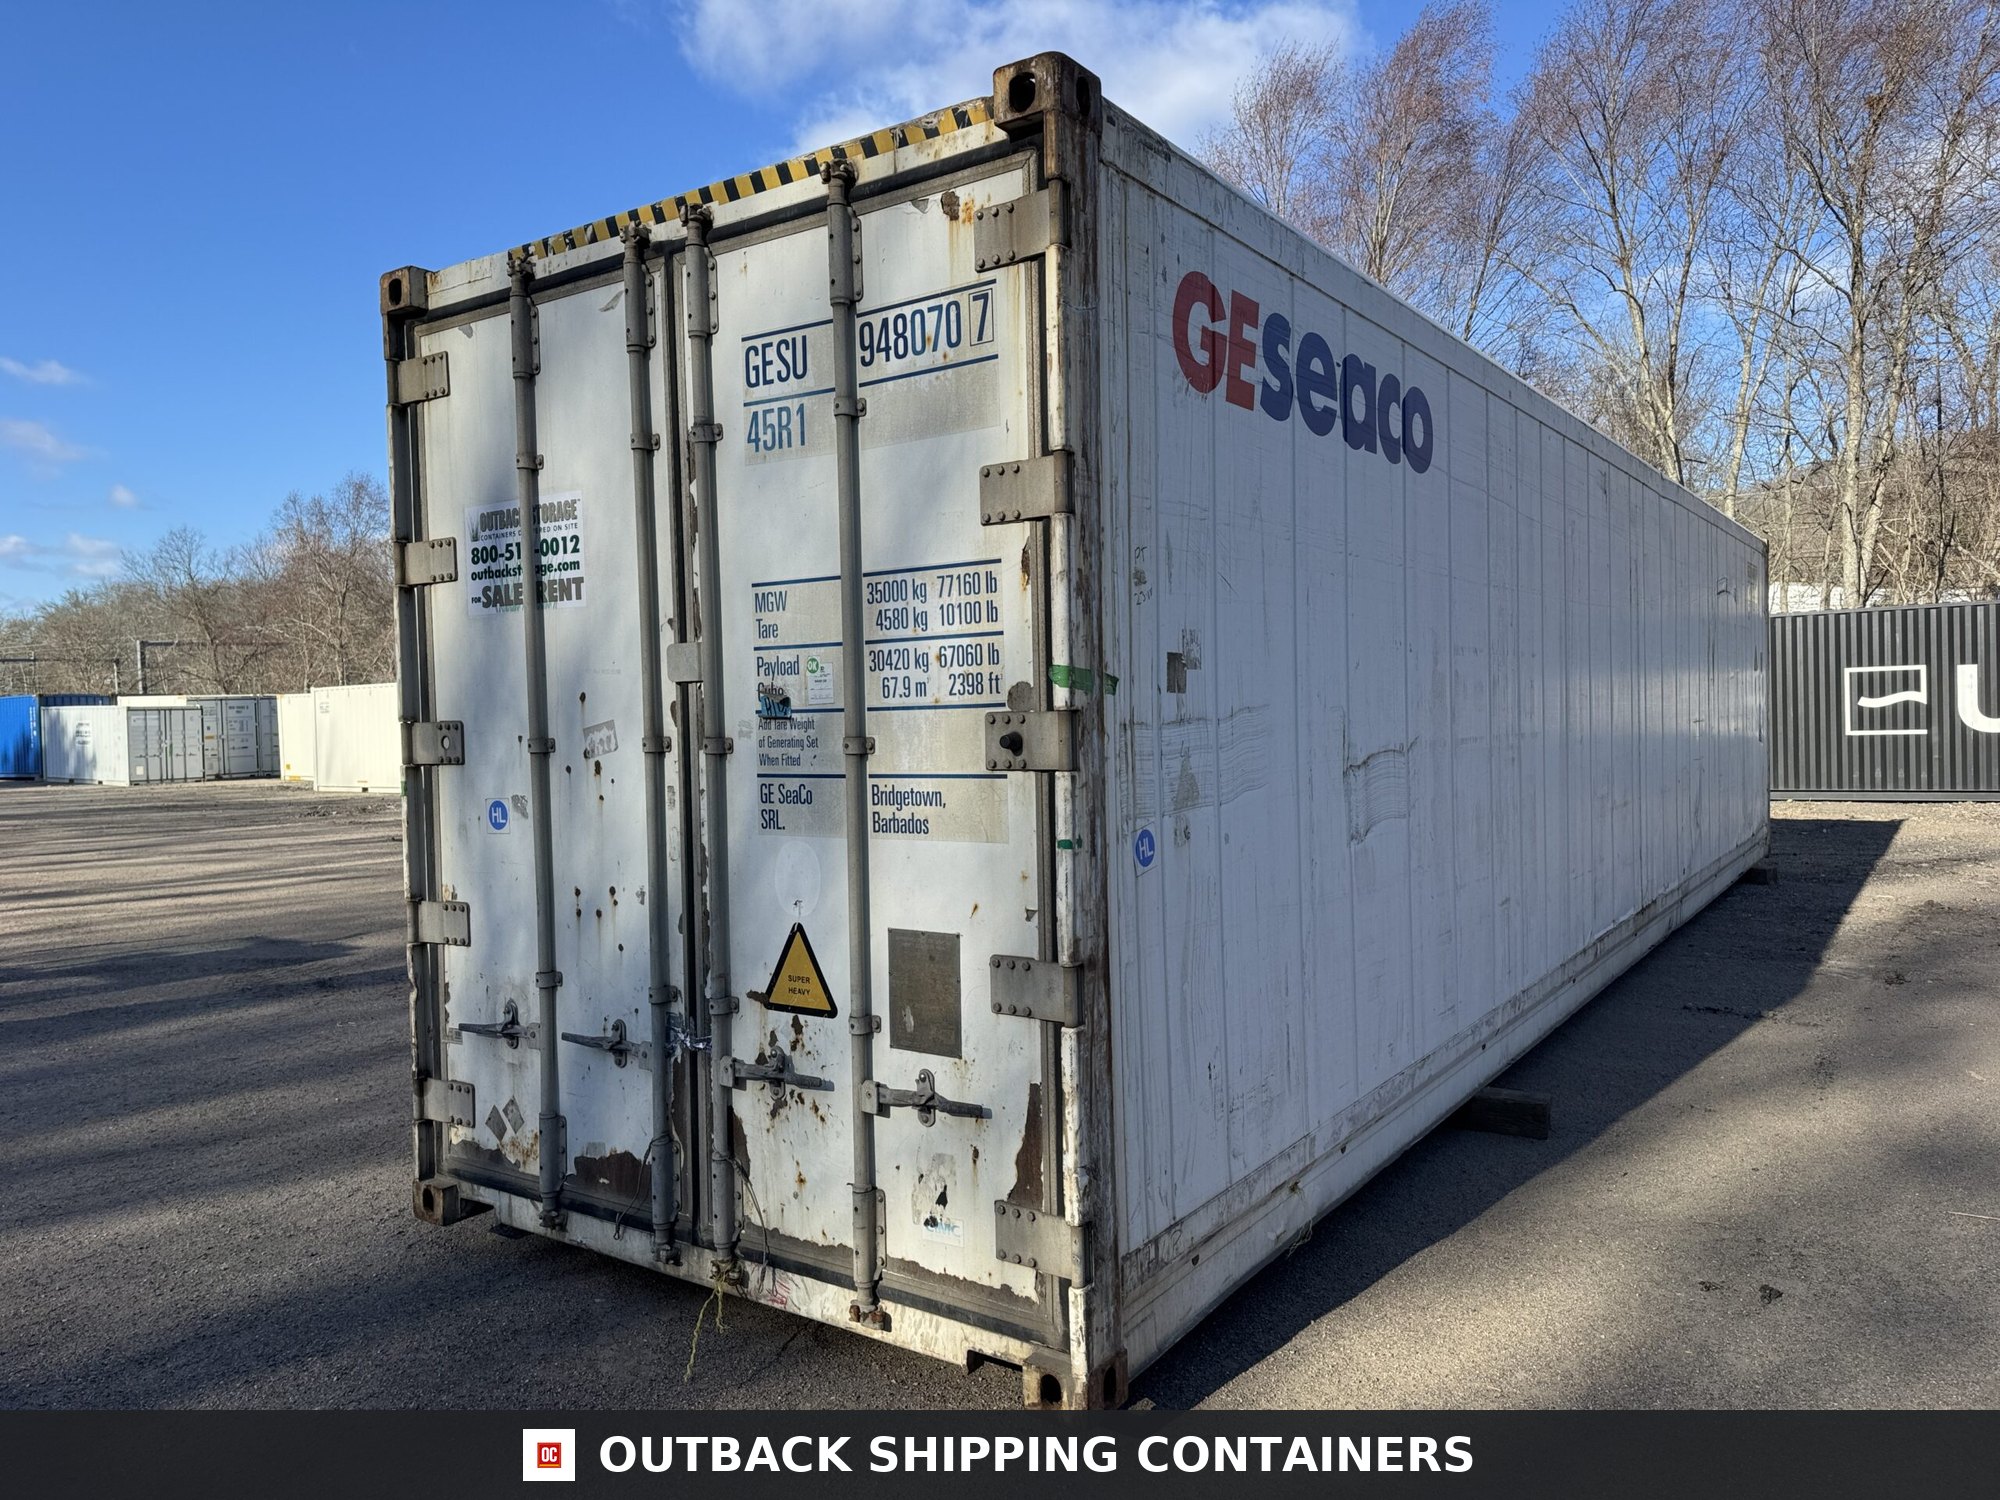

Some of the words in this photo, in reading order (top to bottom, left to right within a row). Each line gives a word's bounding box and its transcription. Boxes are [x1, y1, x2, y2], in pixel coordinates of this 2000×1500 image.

[745, 335, 808, 388] GESU
[859, 300, 962, 367] 948070
[972, 292, 990, 343] 7
[747, 403, 806, 453] 45R1
[480, 508, 521, 532] OUTBAC
[565, 522, 578, 531] SITE
[480, 530, 516, 542] CONTAINERS
[471, 534, 580, 565] 800-51-0012
[471, 560, 580, 581] outbackstage.com
[471, 596, 482, 604] FOR
[482, 583, 524, 609] SALE
[535, 576, 585, 604] RENT
[754, 591, 787, 613] MGW
[867, 579, 908, 604] 35000
[912, 578, 927, 604] kg
[936, 571, 981, 598] 77160
[985, 570, 998, 594] lb
[756, 618, 779, 639] Tare
[876, 606, 909, 631] 4580
[912, 606, 928, 632] kg
[939, 600, 981, 626] 10100
[986, 599, 998, 623] lb
[756, 655, 800, 681] Payload
[869, 648, 910, 673] 30420
[914, 647, 929, 674] kg
[939, 643, 983, 668] 67060
[987, 642, 1000, 666] lb
[808, 660, 819, 671] OK
[882, 675, 911, 699] 67.9
[948, 672, 984, 697] 2398
[758, 717, 772, 730] Add
[774, 718, 788, 730] Tare
[790, 716, 816, 733] Weight
[758, 735, 766, 748] of
[767, 735, 805, 751] Generating
[806, 735, 819, 749] Set
[758, 753, 780, 767] When
[781, 753, 801, 767] Fitted
[760, 784, 774, 805] GE
[778, 784, 813, 806] SeaCo
[871, 784, 946, 812] Bridgetown,
[490, 806, 507, 824] HL
[761, 809, 786, 831] SRL.
[872, 811, 929, 835] Barbados
[787, 974, 811, 984] SUPER
[788, 987, 811, 996] HEAVY
